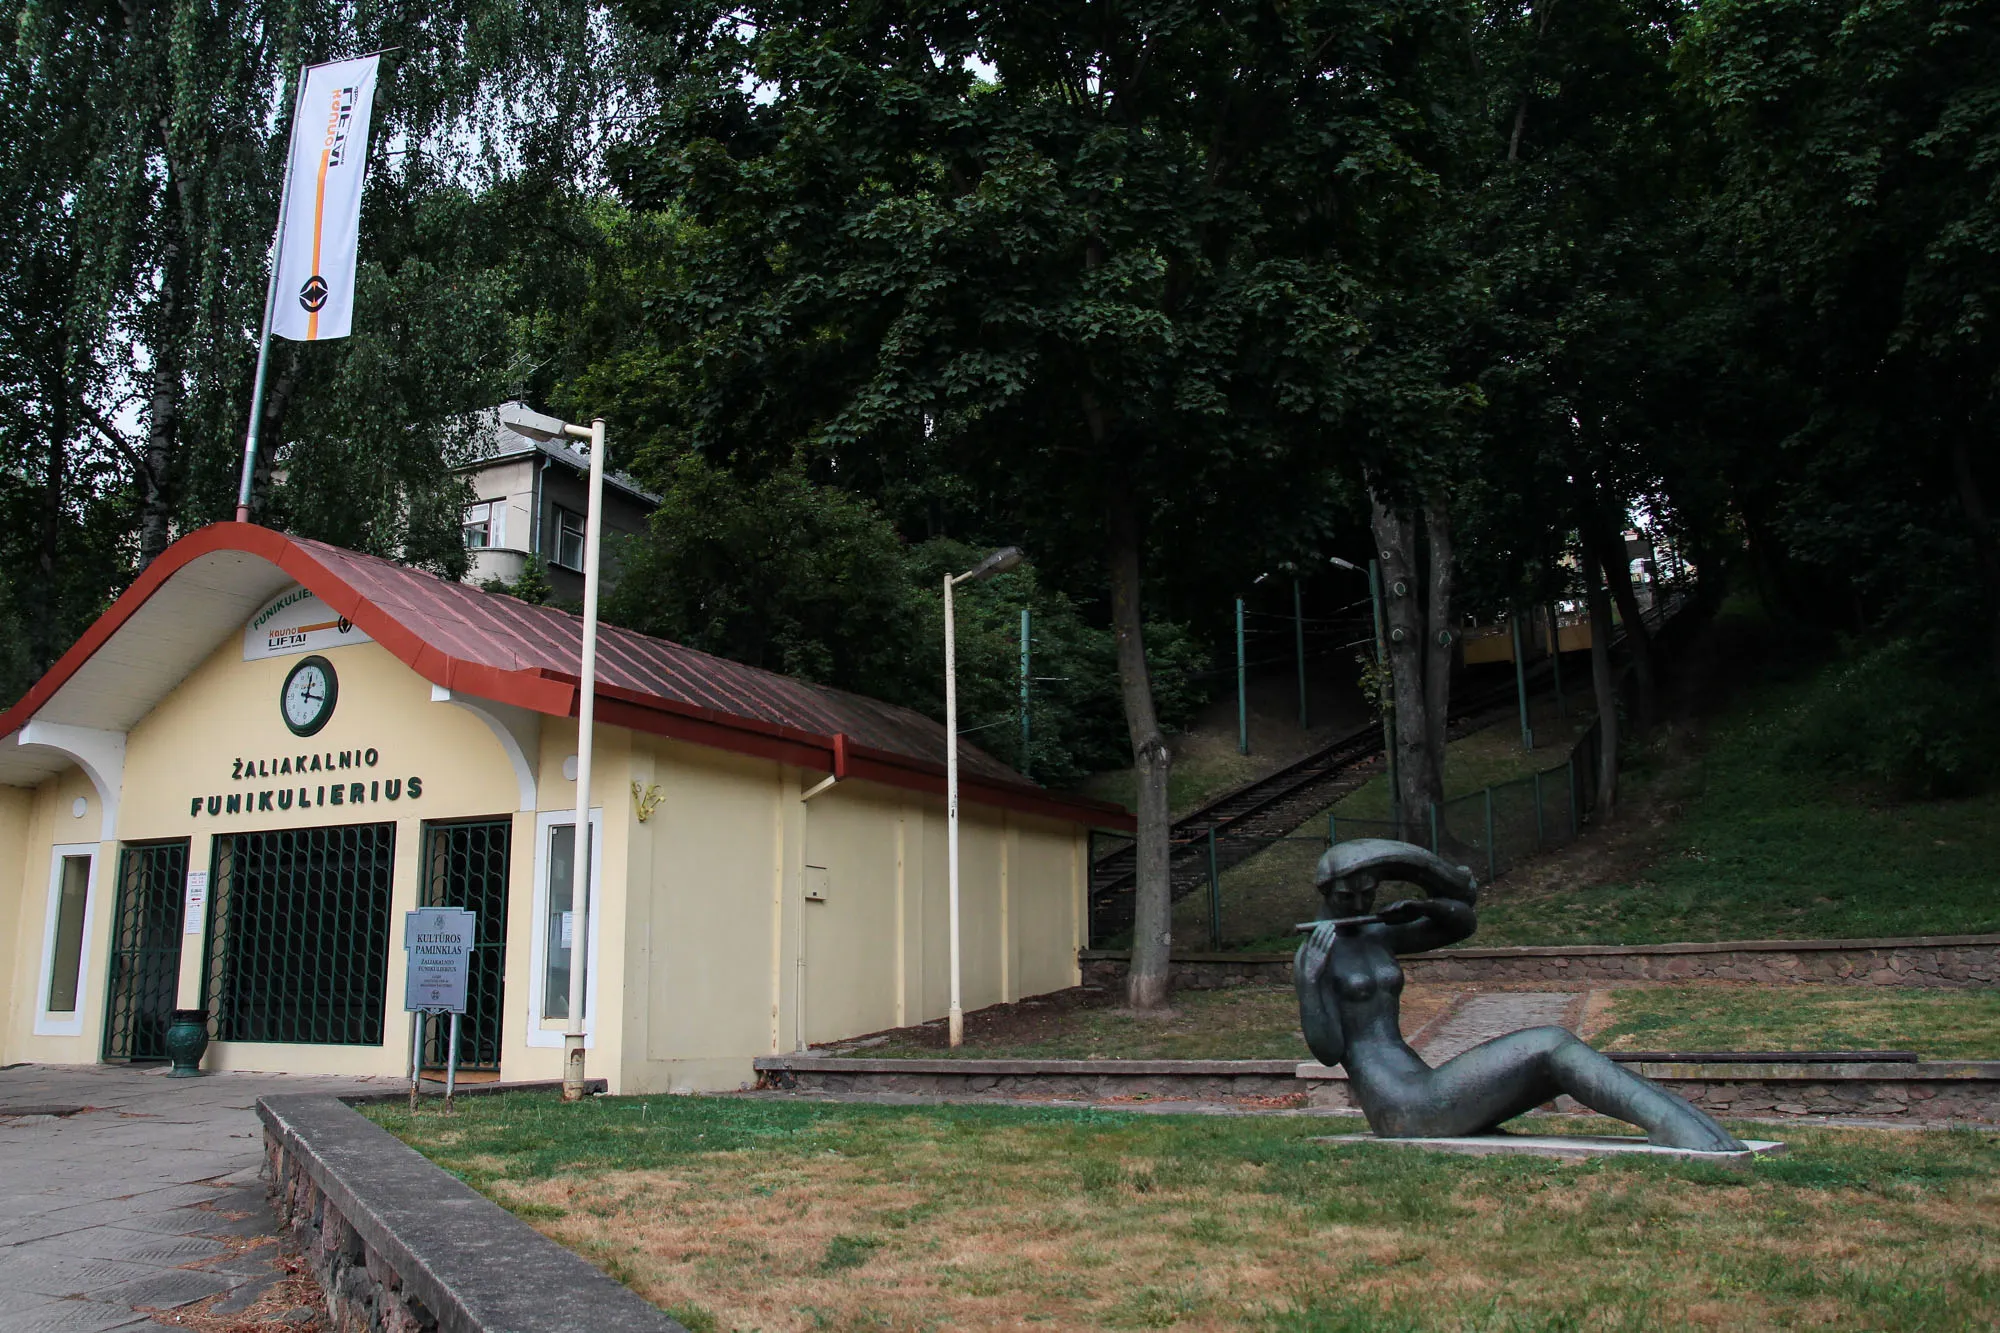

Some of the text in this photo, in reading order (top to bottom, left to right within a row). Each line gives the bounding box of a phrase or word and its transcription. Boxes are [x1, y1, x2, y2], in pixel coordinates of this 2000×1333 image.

[253, 588, 316, 630] FUNIKULIE
[268, 634, 307, 647] LIFTAI
[231, 747, 379, 780] ŽALIAKALNIO
[190, 776, 423, 817] FUNIKULIERIUS
[416, 946, 462, 955] PAMINKLAS
